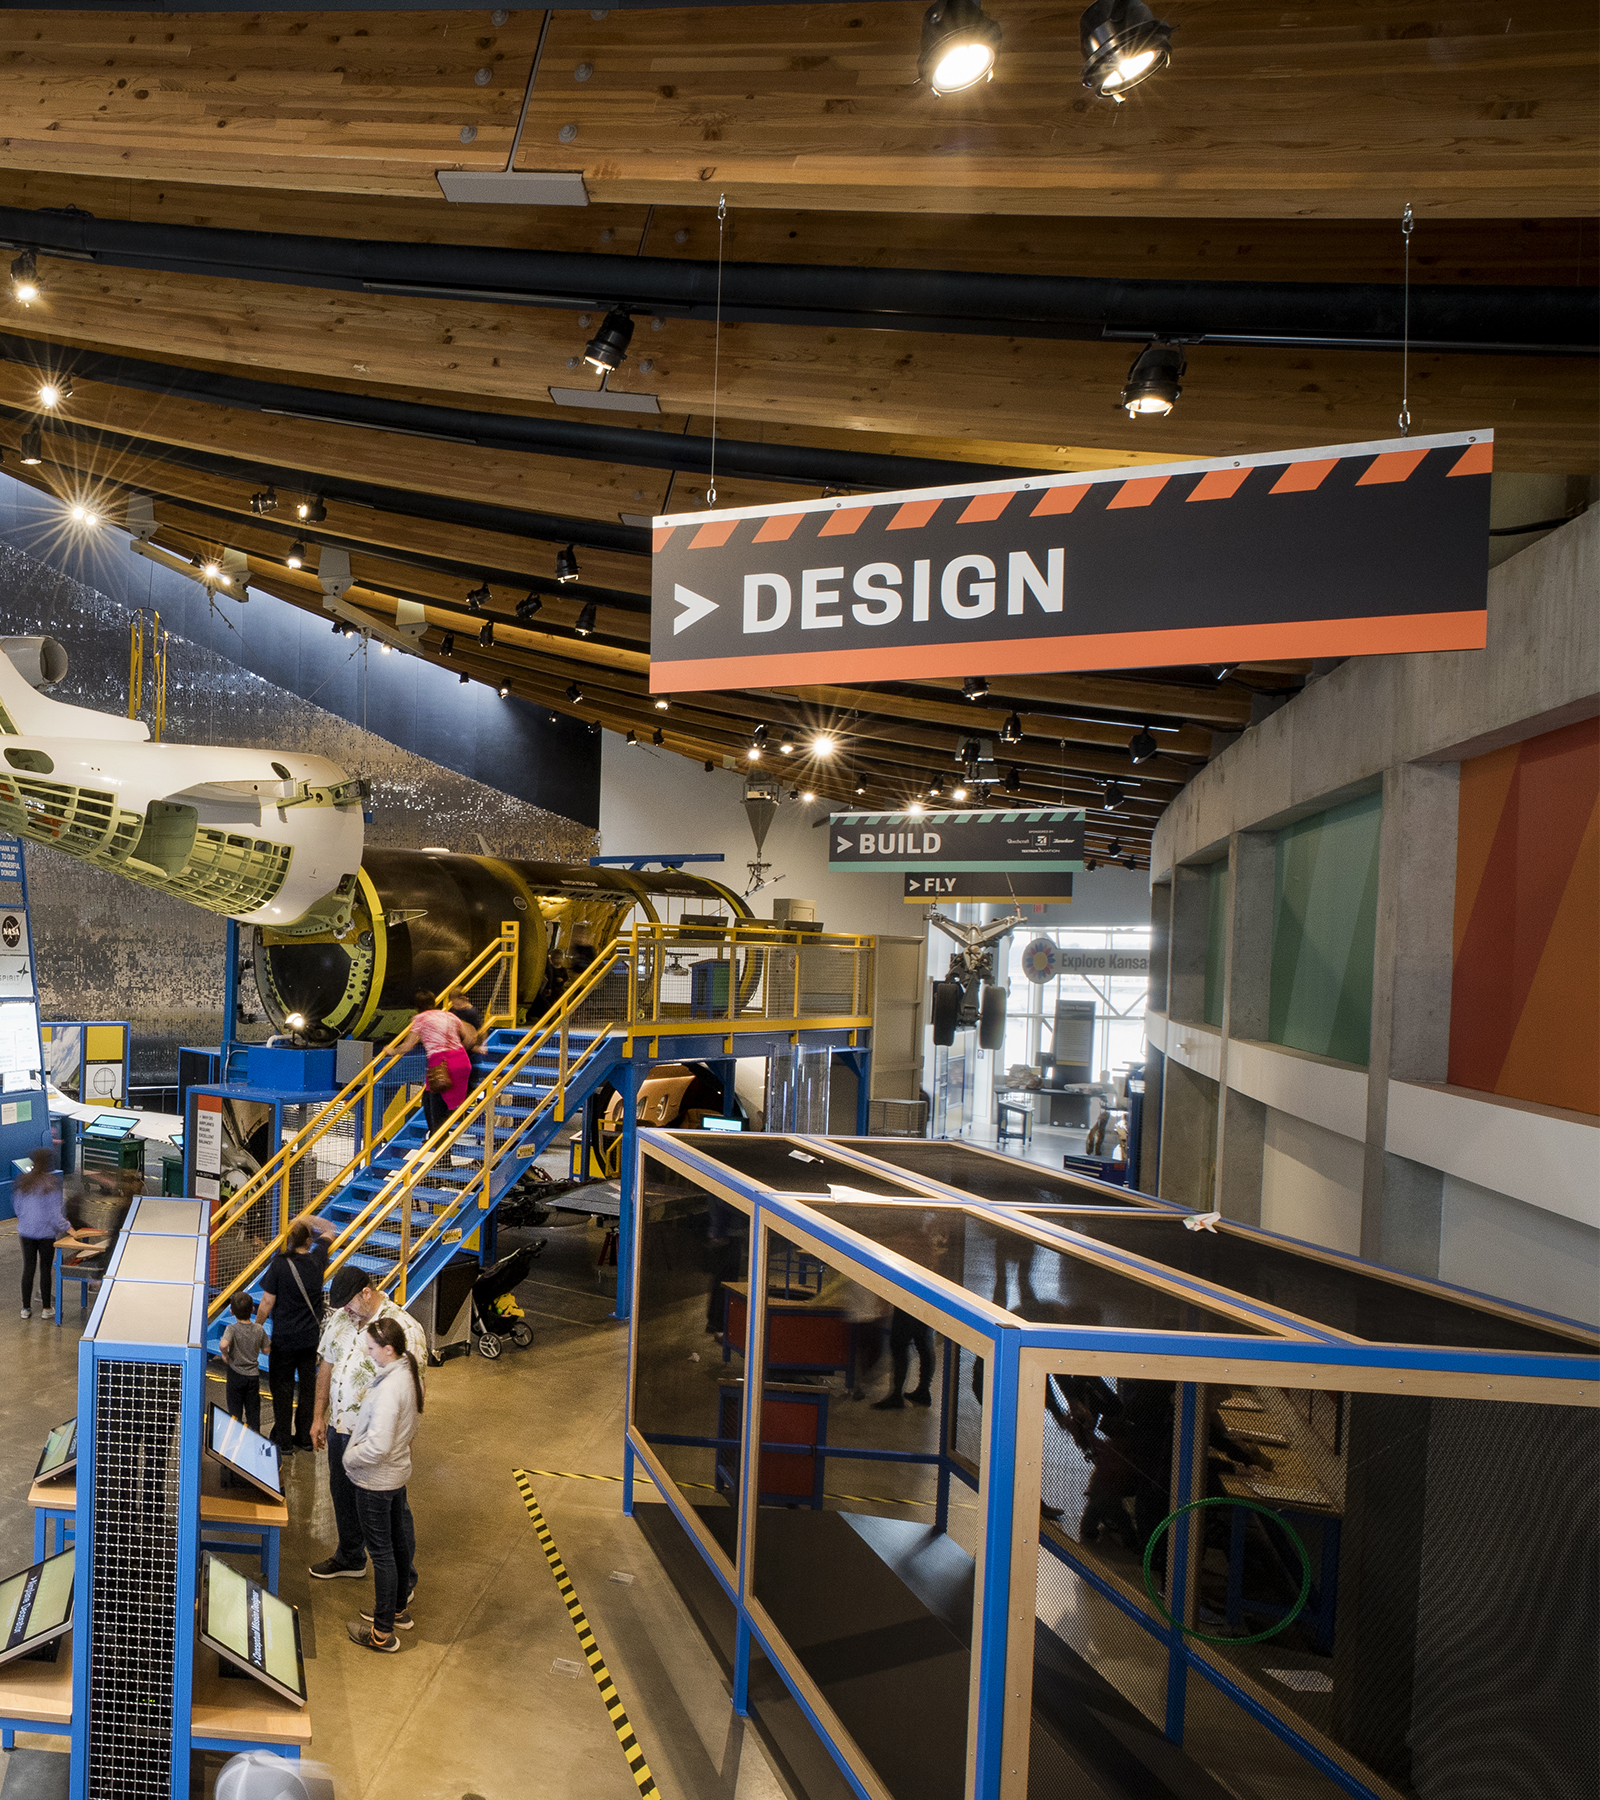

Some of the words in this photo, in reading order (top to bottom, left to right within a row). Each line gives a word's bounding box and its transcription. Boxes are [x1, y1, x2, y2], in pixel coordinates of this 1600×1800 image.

[743, 547, 1065, 634] DESIGN
[9, 845, 19, 854] YOU
[859, 832, 942, 854] BUILD
[7, 853, 16, 861] OUR
[0, 869, 17, 877] DONORS
[924, 877, 957, 892] FLY
[2, 927, 20, 936] NASA
[1061, 953, 1106, 971] Explore
[251, 1610, 261, 1632] Mission
[252, 1629, 263, 1661] Conceptual
